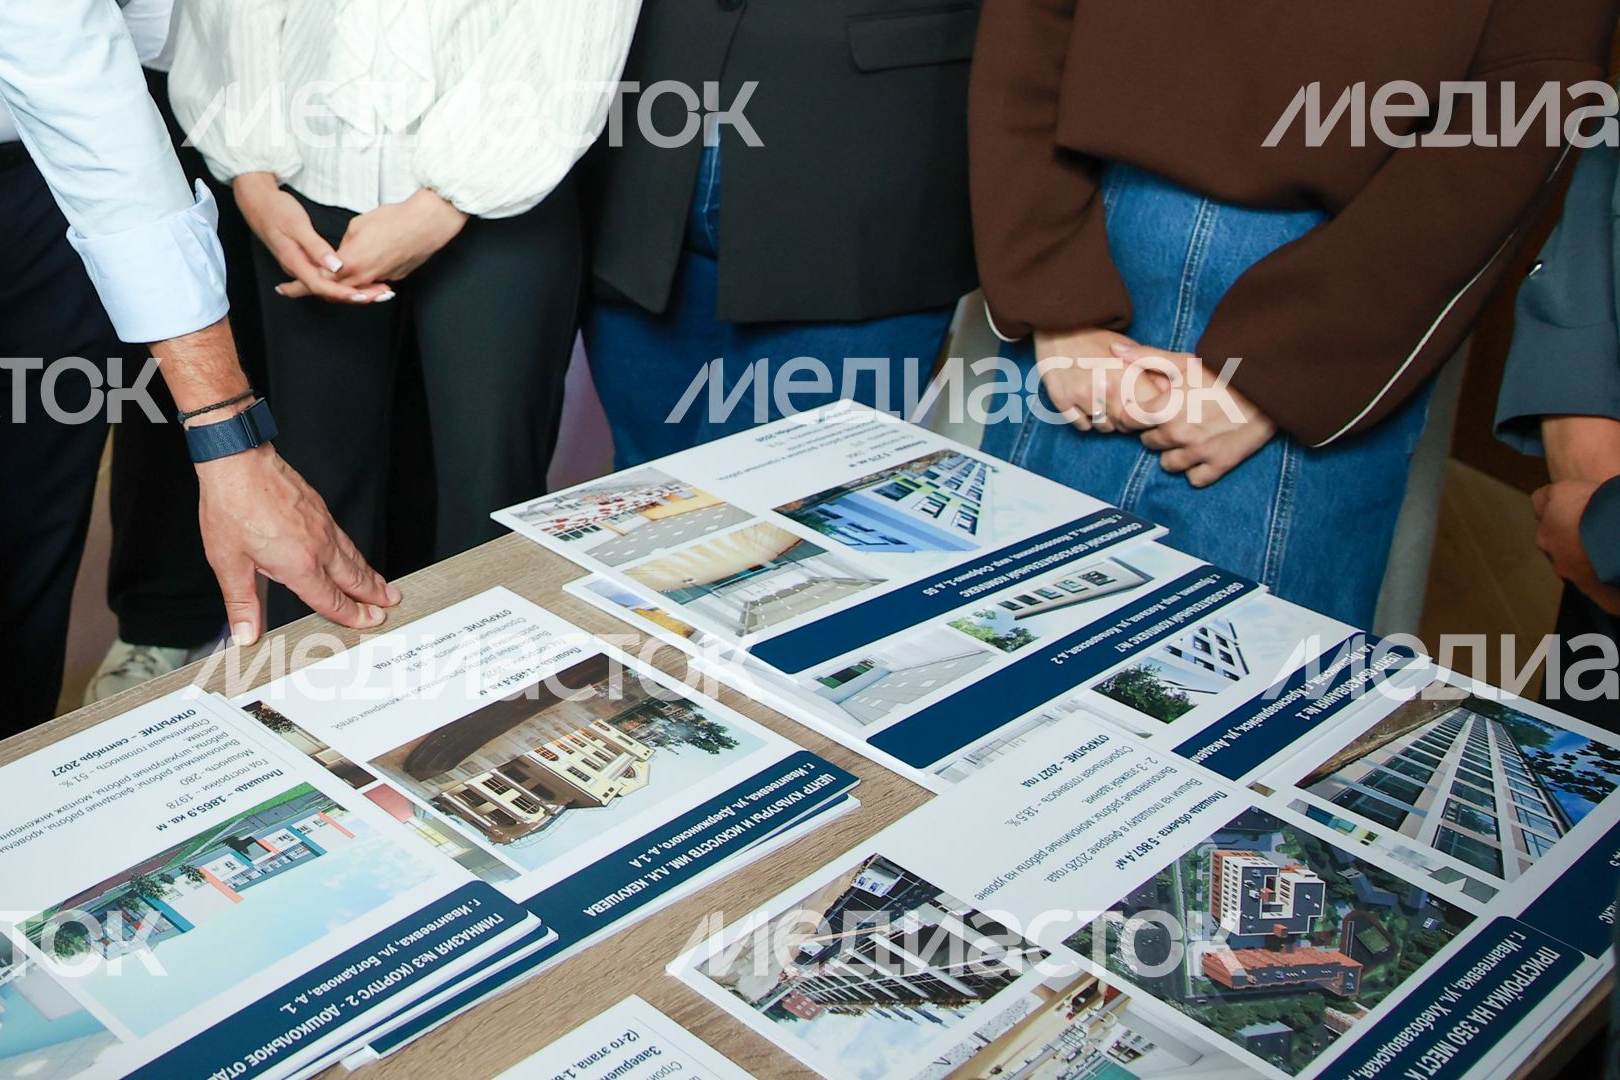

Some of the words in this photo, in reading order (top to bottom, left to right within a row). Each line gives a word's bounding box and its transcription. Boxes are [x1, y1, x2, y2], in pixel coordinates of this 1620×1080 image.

[1168, 581, 1244, 623] ОБРАЗОВАТЕЛЬНЫЙ
[462, 608, 512, 632] ОТКРЫТИЕ
[137, 708, 196, 737] ОТКРЫТИЕ
[146, 717, 210, 748] Строительная
[182, 724, 219, 742] систем.
[78, 737, 129, 761] сентябрь
[95, 744, 148, 770] готовность
[172, 738, 241, 771] Выполняемые
[204, 747, 255, 772] Мощность
[1062, 733, 1110, 763] ОТКРЫТИЕ
[50, 759, 81, 777] 2027
[131, 747, 192, 778] штукатурные
[247, 757, 269, 769] Год
[1036, 762, 1063, 780] 2027
[1080, 744, 1134, 778] Строительная
[178, 771, 202, 786] 280
[201, 765, 251, 791] постройки
[233, 767, 284, 792] Площадь
[743, 766, 809, 801] Ивантеевка,
[802, 772, 836, 795] ЦЕНТР
[1019, 775, 1040, 788] год
[1039, 775, 1084, 803] готовность
[1109, 766, 1140, 788] этажей
[1120, 765, 1178, 802] Выполняемые
[1170, 776, 1203, 797] Вышли
[53, 793, 93, 814] монтаж
[84, 786, 135, 812] фасадные
[164, 792, 194, 810] 1978
[186, 794, 227, 818] 1865,9
[749, 790, 805, 823] КУЛЬТУРЫ
[1090, 798, 1125, 822] работы:
[1188, 789, 1228, 814] Площадь
[166, 813, 187, 824] кв.
[1014, 805, 1039, 822] 18,5
[1123, 800, 1165, 828] площадку
[1157, 812, 1193, 837] объекта
[656, 805, 736, 849] Дзержинского,
[1044, 819, 1095, 853] монолитные
[687, 823, 745, 858] ИСКУССТВ
[1086, 829, 1124, 855] феврале
[1123, 841, 1154, 862] 867,4
[664, 853, 693, 869] ИМ.
[1015, 849, 1048, 873] работы
[1064, 851, 1093, 871] 2026
[1042, 866, 1069, 883] года.
[582, 878, 647, 916] КЕКУШЕВА
[973, 877, 1006, 901] уровне
[393, 904, 472, 946] Ивантеевка,
[433, 912, 504, 955] ГИМНАЗИЯ
[376, 942, 399, 957] ул.
[306, 955, 381, 996] Богданова,
[1450, 938, 1521, 990] Ивантеевка,
[356, 961, 414, 1000] (КОРПУС
[1482, 946, 1559, 1009] ПРИСТРОЙКА
[1437, 985, 1462, 1003] ул.
[244, 1003, 340, 1066] ДОШКОЛЬНОЕ
[1445, 1019, 1480, 1045] 350
[1415, 1039, 1458, 1076] МЕСТ
